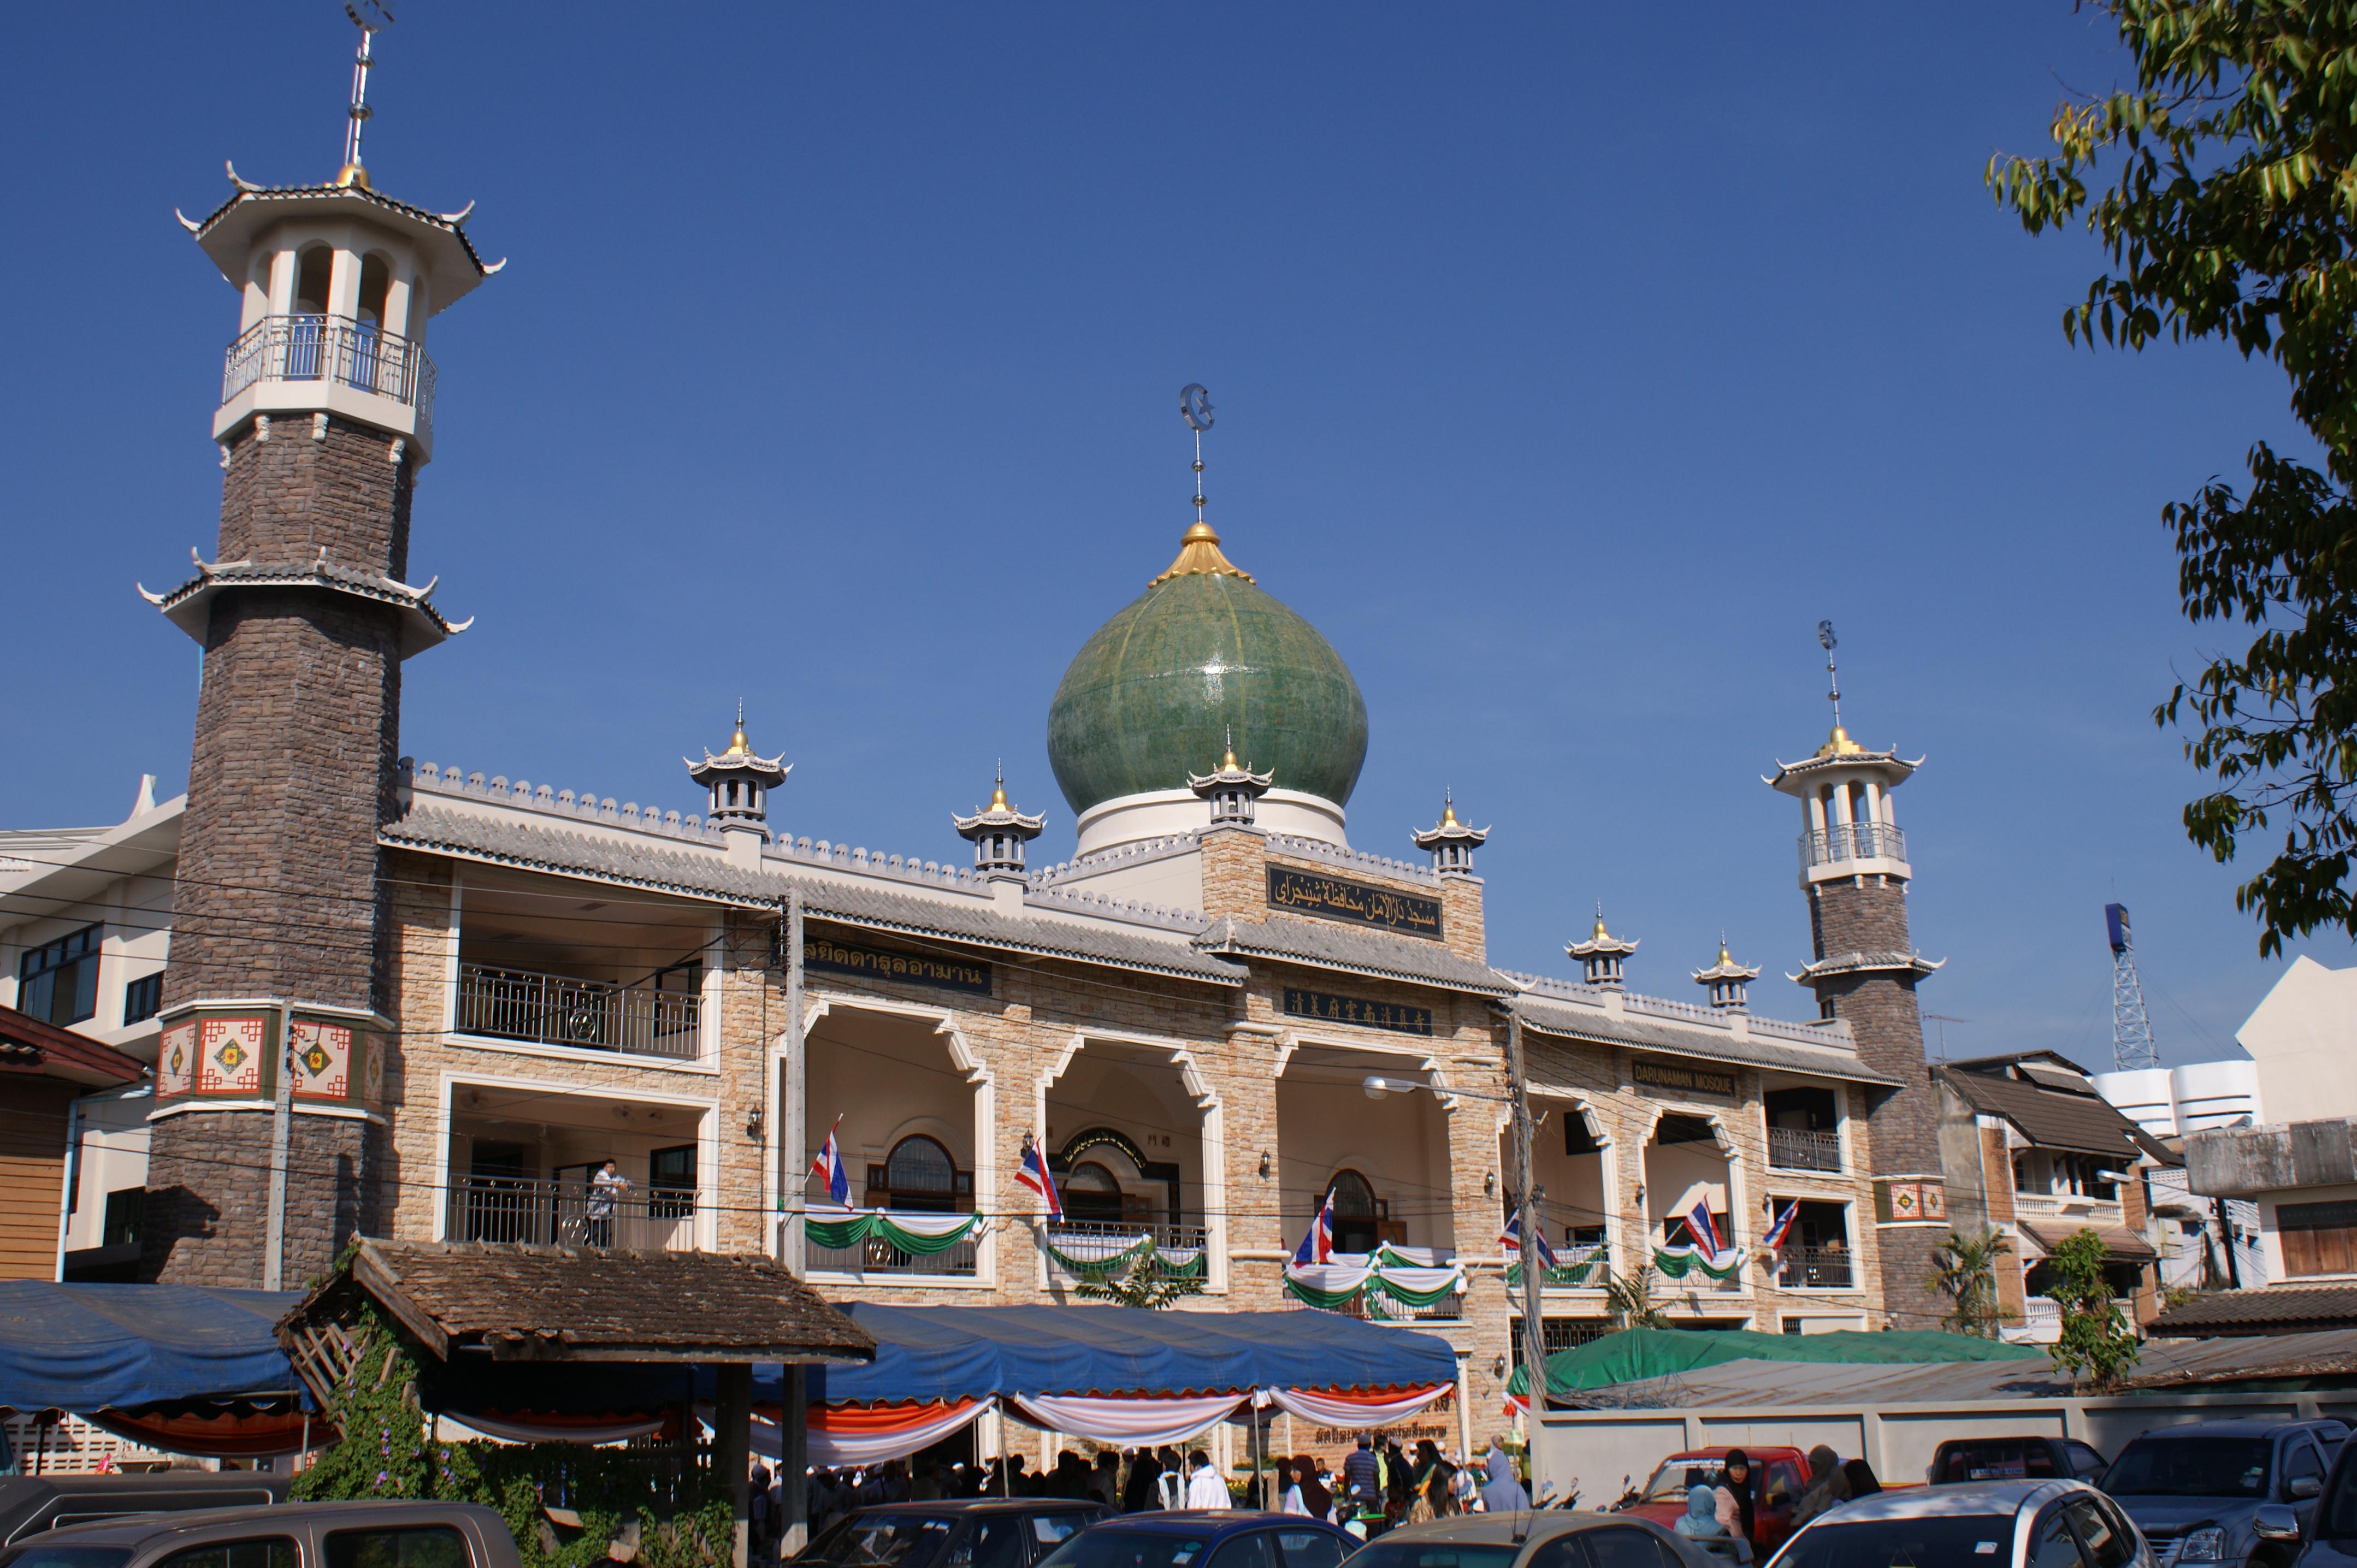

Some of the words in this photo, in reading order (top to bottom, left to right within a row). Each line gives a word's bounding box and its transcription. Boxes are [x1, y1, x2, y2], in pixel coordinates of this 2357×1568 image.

[804, 940, 982, 984] สยิดดารุลอามาน
[1635, 1064, 1692, 1087] DARUNAMAN
[1695, 1073, 1732, 1093] MOSQUE
